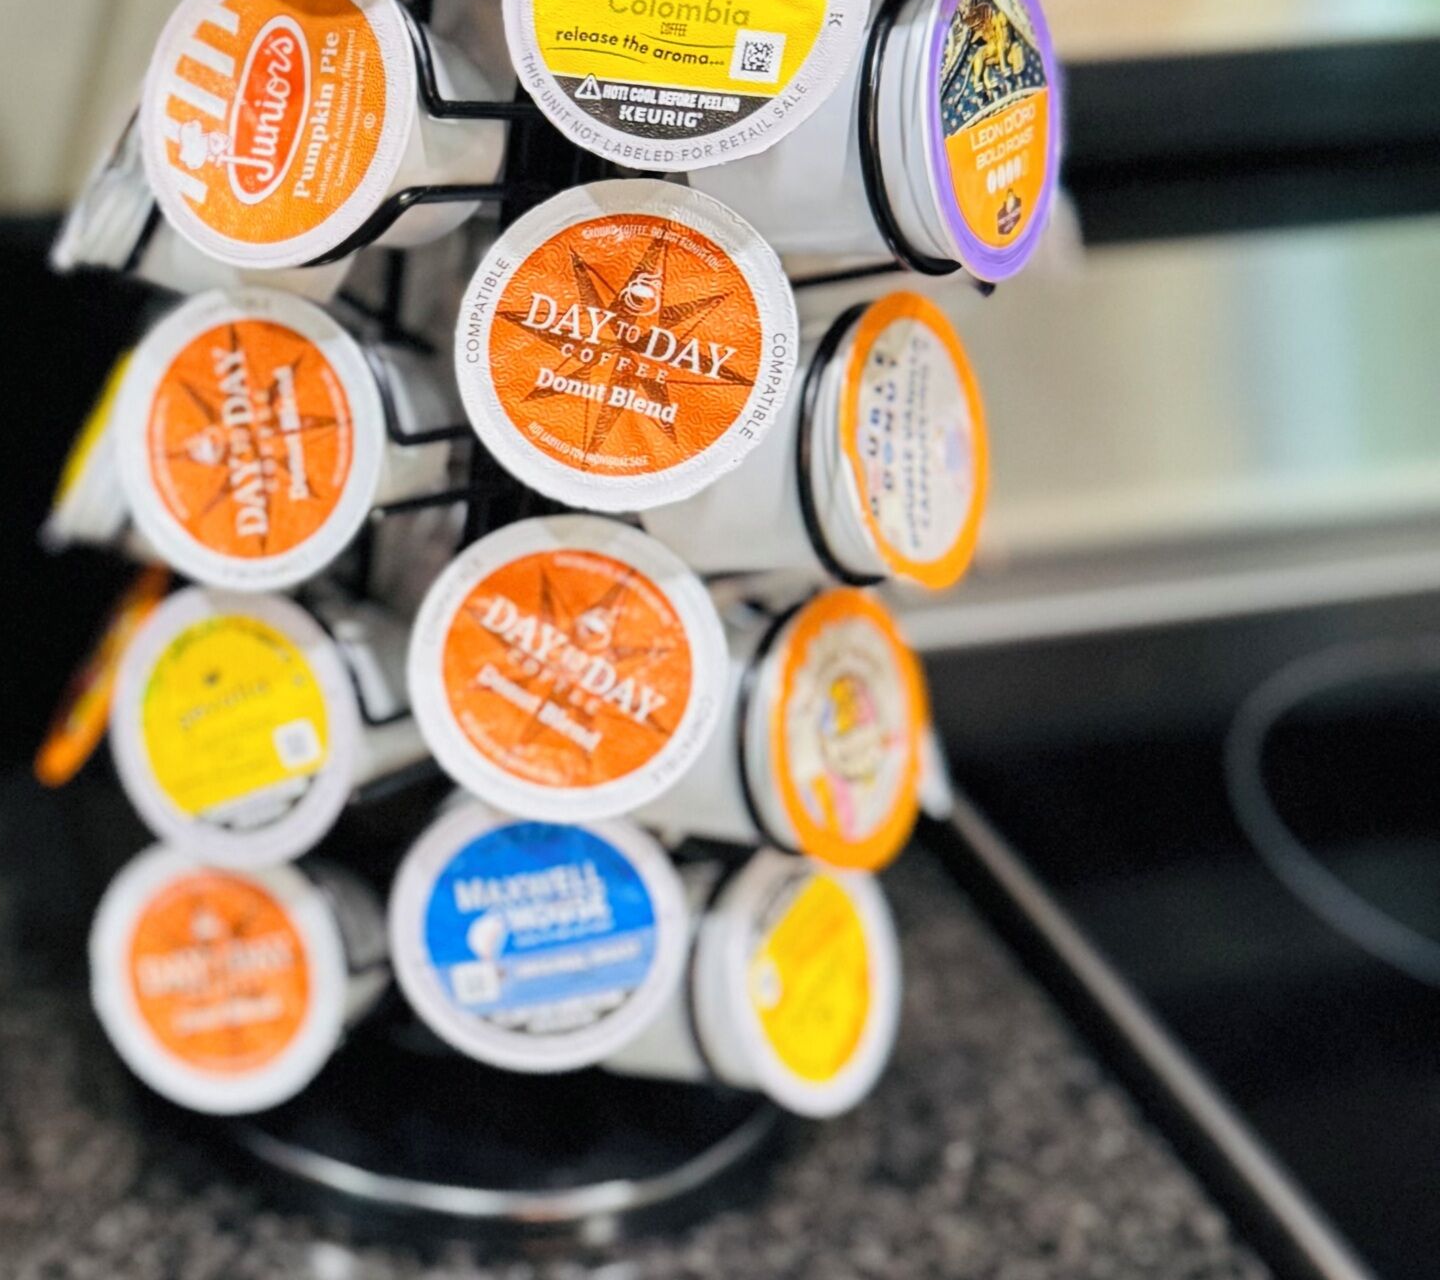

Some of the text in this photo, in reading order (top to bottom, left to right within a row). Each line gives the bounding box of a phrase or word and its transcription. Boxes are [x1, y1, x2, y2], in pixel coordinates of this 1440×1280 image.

[555, 26, 618, 45] release
[623, 33, 648, 54] the
[293, 32, 340, 198] Pumpkin Pie
[522, 53, 808, 162] THIS UNIT NOT LABELED FOR RETAIL SALE
[618, 104, 698, 128] KEURIG
[629, 86, 658, 105] COOL
[659, 91, 697, 108] BEFORE
[697, 94, 741, 112] PEELING
[466, 257, 509, 363] COMPATIBLE
[521, 291, 737, 380] DAY TO DAY
[212, 346, 254, 426] DAY
[535, 367, 679, 424] Donut Blend
[560, 342, 670, 385] COFFEE
[739, 333, 787, 440] COMPATIBLE
[229, 460, 269, 538] DAY
[478, 595, 568, 662] DAY
[582, 656, 668, 723] DAY
